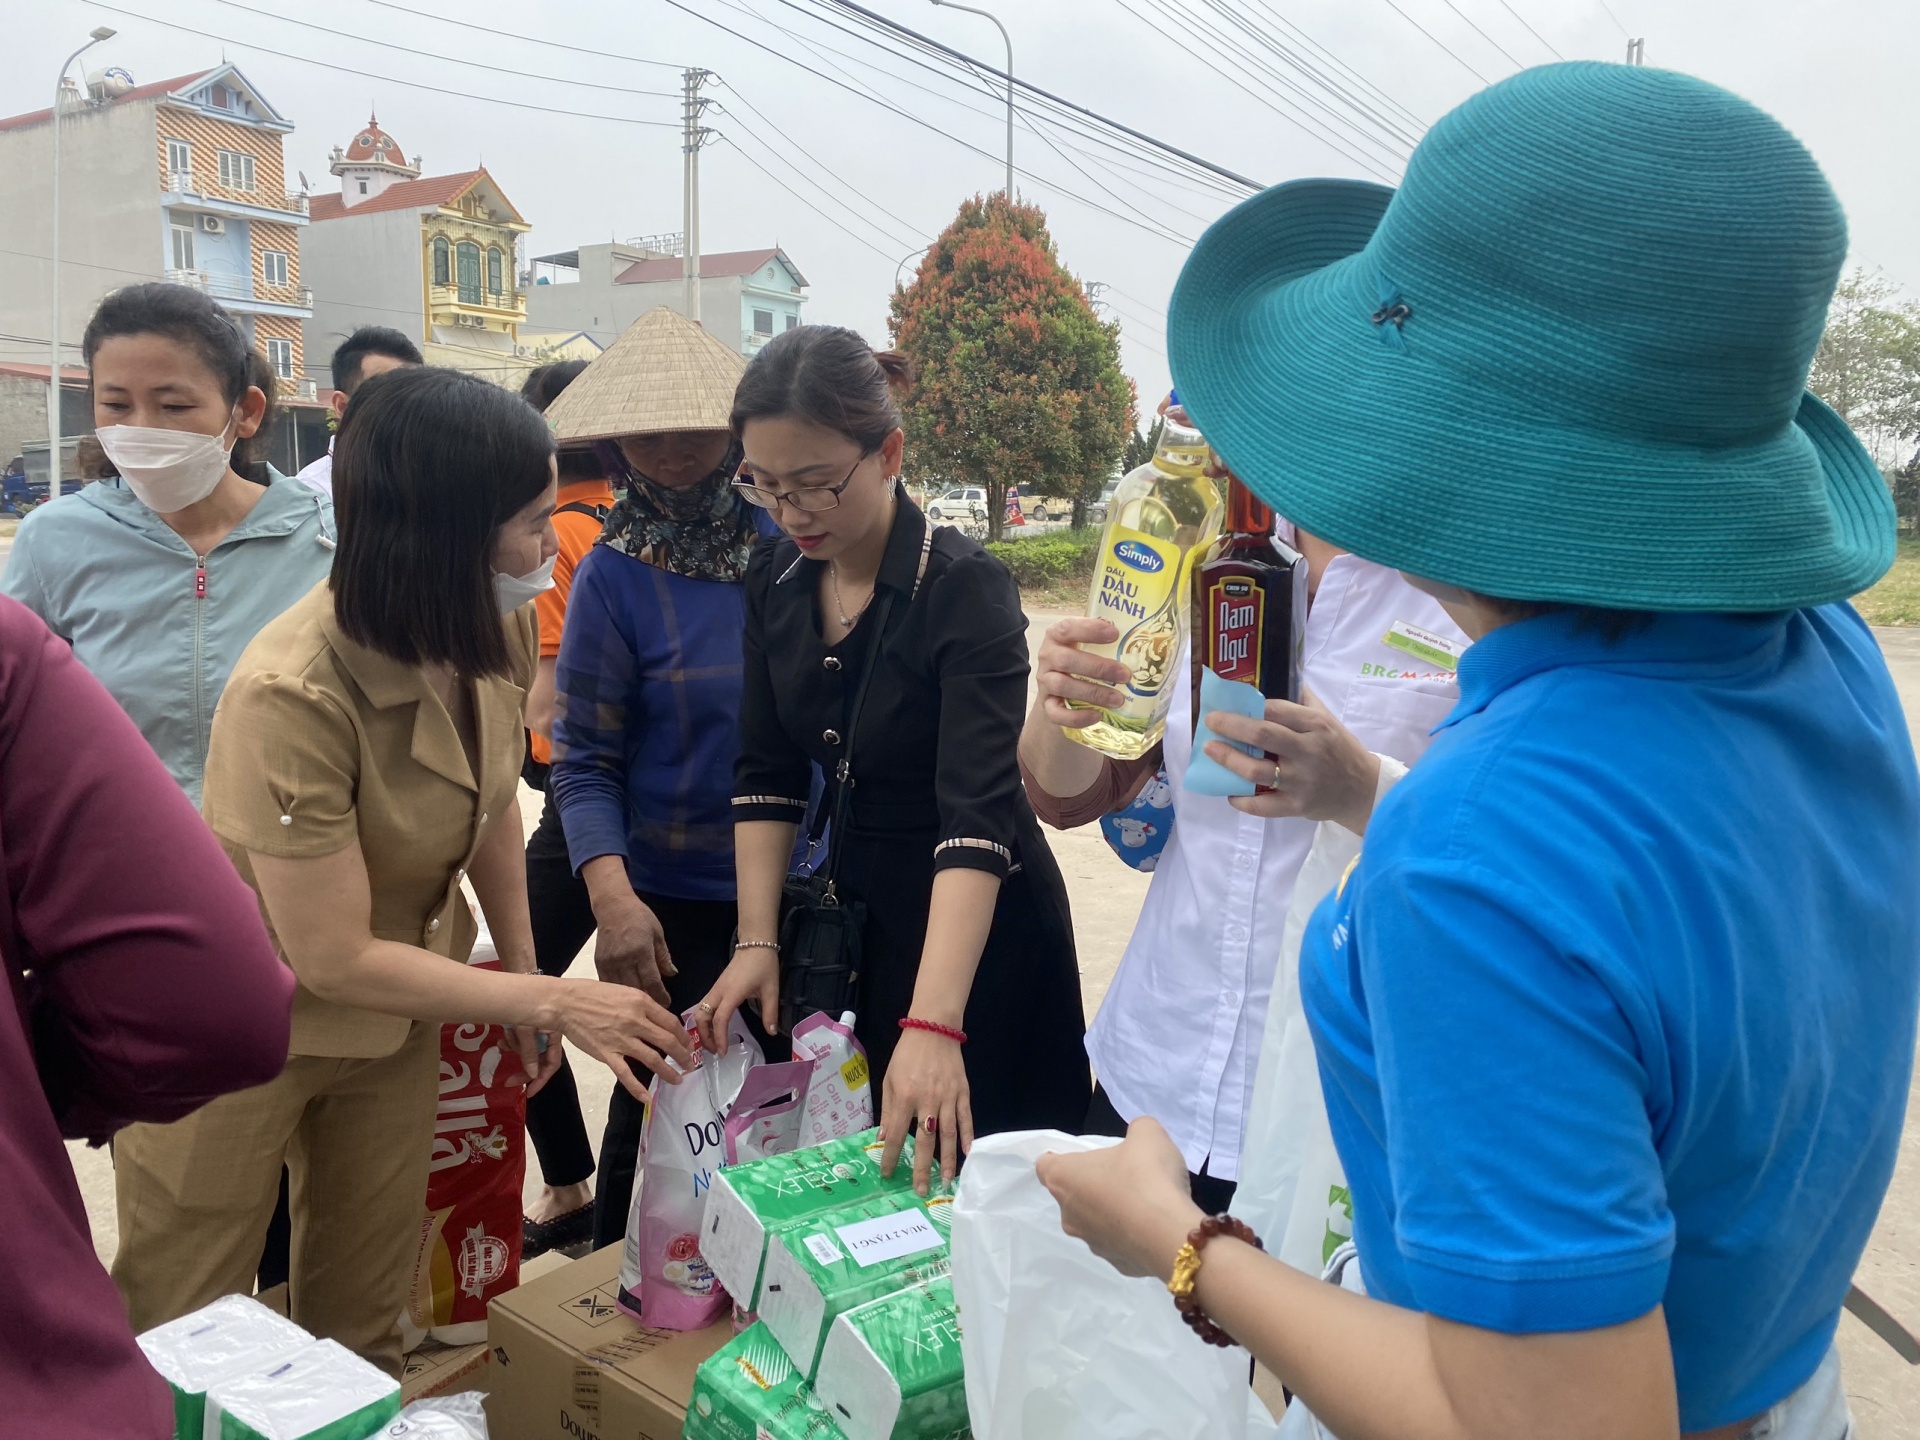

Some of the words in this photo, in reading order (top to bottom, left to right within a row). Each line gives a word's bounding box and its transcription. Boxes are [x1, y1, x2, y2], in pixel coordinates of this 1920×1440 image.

[1118, 543, 1161, 570] Simply
[1219, 601, 1254, 632] Nam
[1218, 632, 1250, 674] Ngư
[766, 1159, 867, 1198] CORELEX
[893, 1230, 902, 1239] 2
[901, 1223, 929, 1236] MUA
